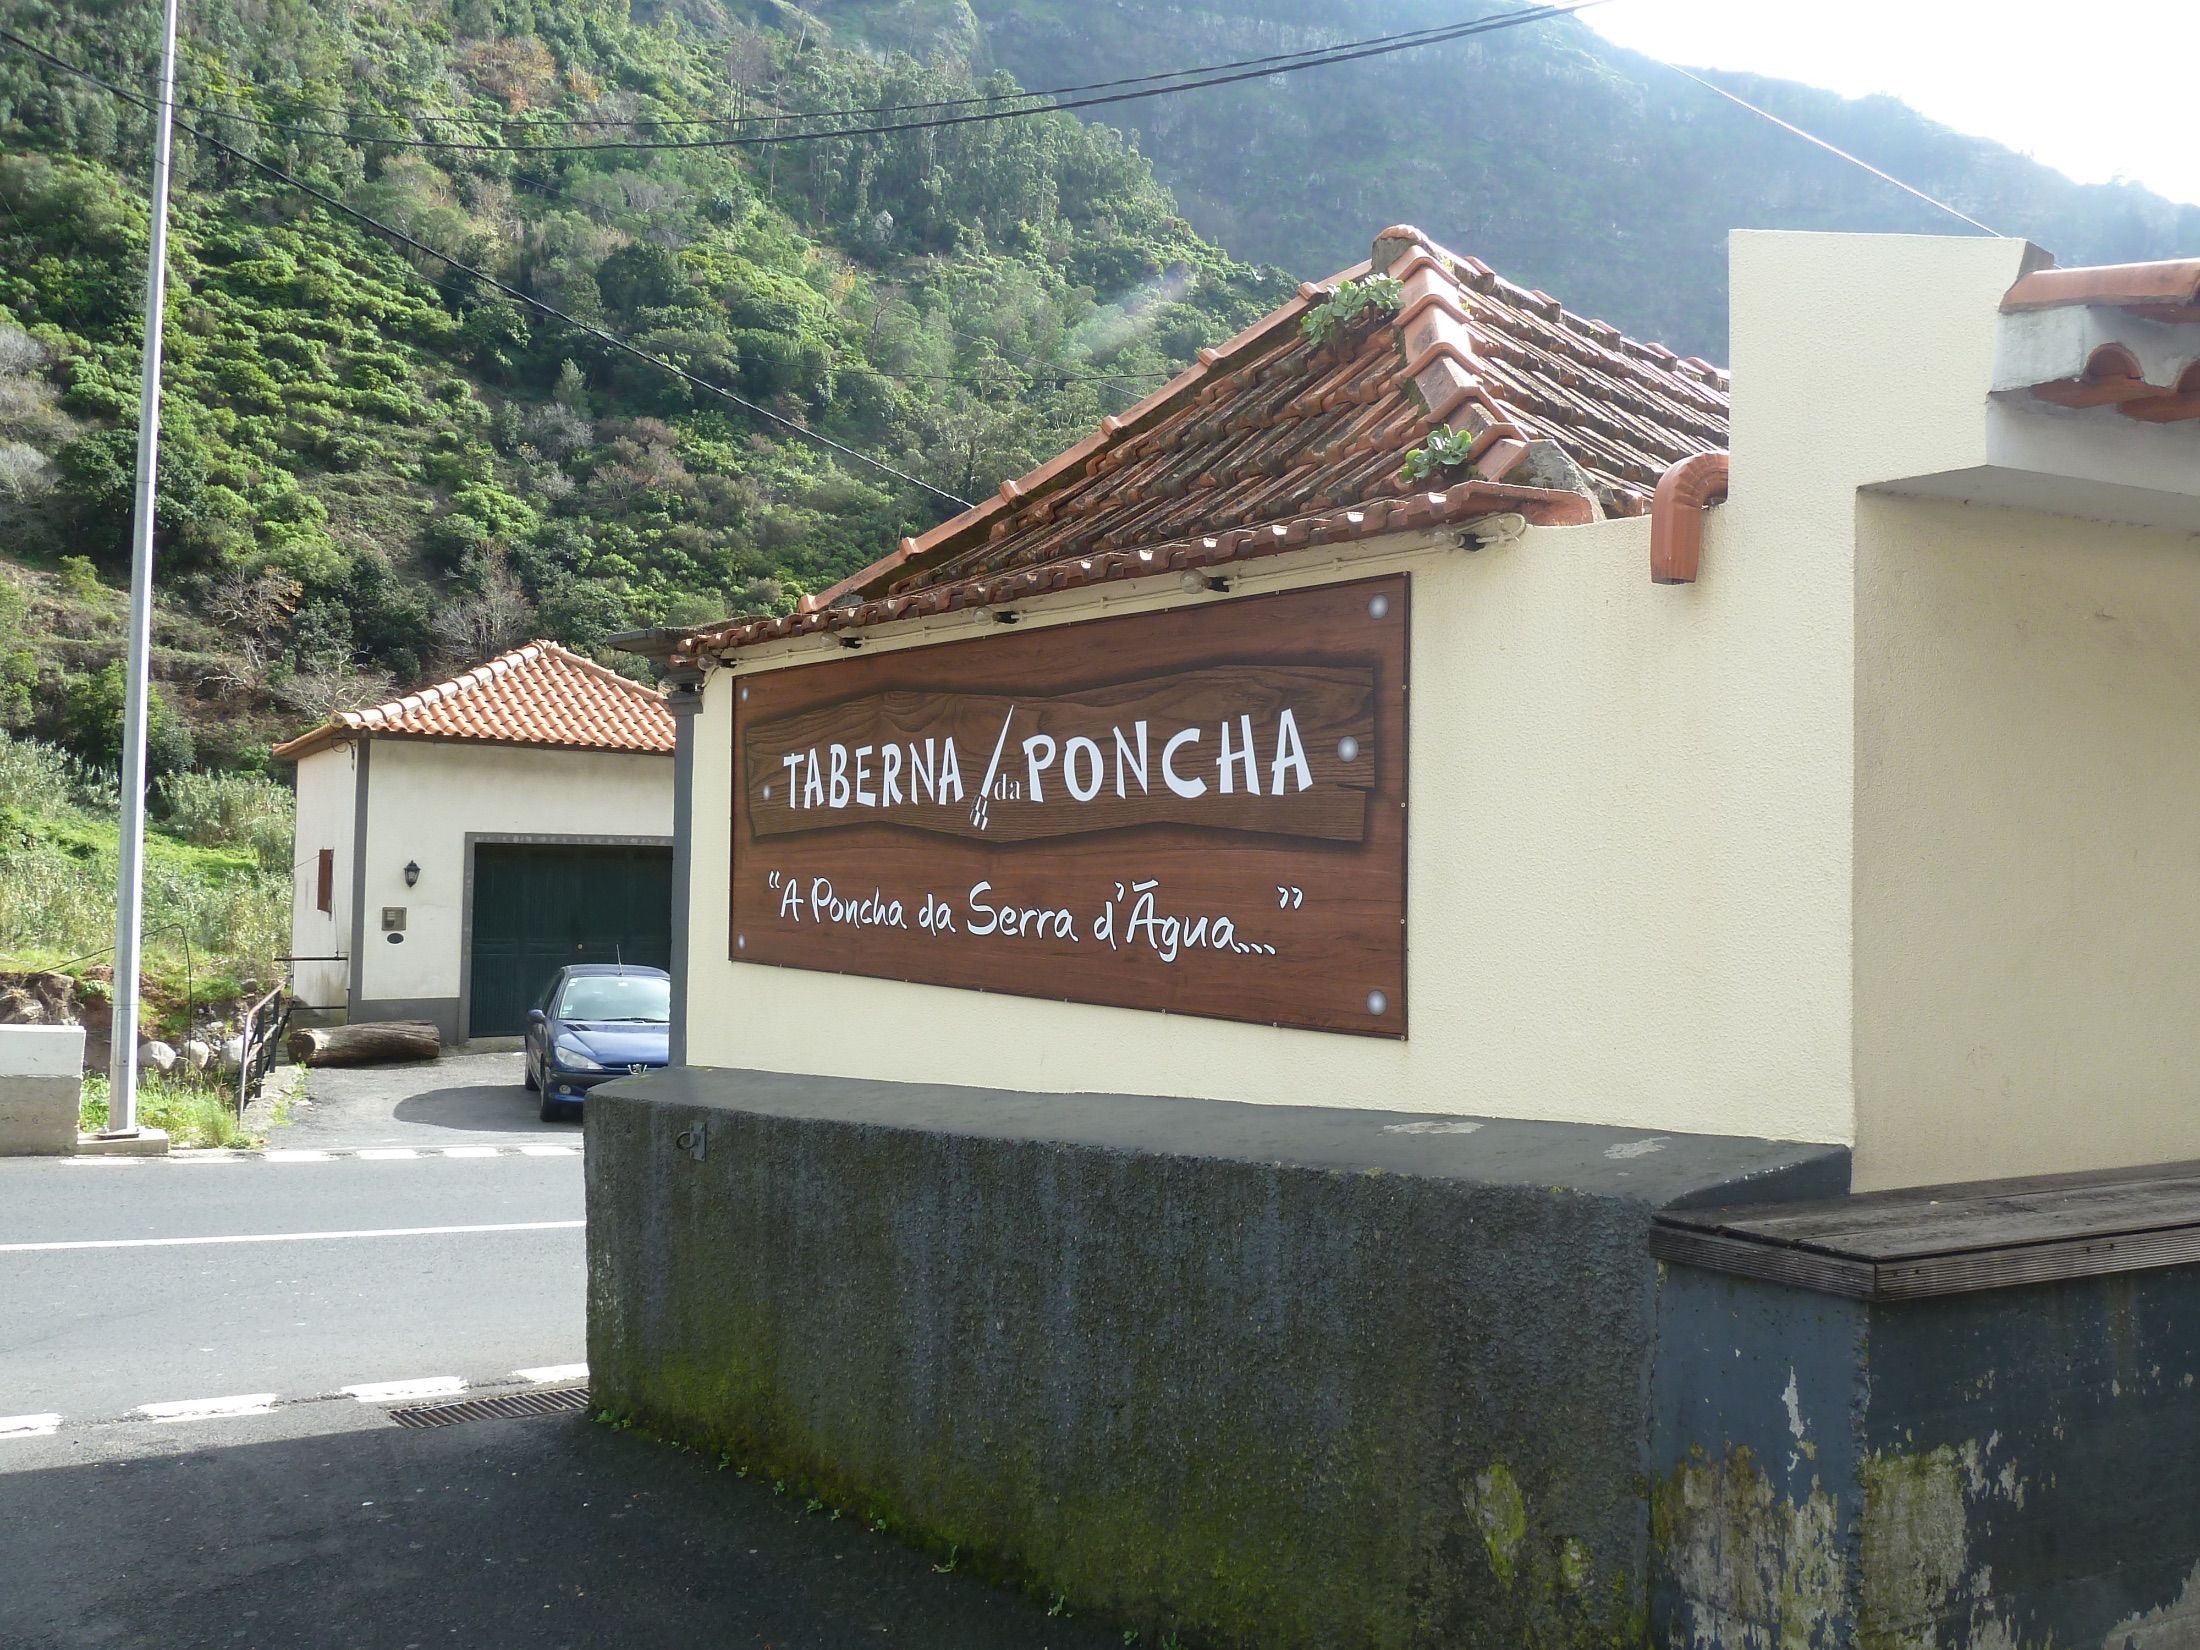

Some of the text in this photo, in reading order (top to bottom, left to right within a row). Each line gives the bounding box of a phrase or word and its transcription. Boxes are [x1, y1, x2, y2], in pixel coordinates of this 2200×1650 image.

[782, 708, 1314, 810] TABERNA da PONCHA
[810, 876, 907, 930] Poncha
[918, 892, 957, 933] da
[966, 880, 1080, 943] Serra
